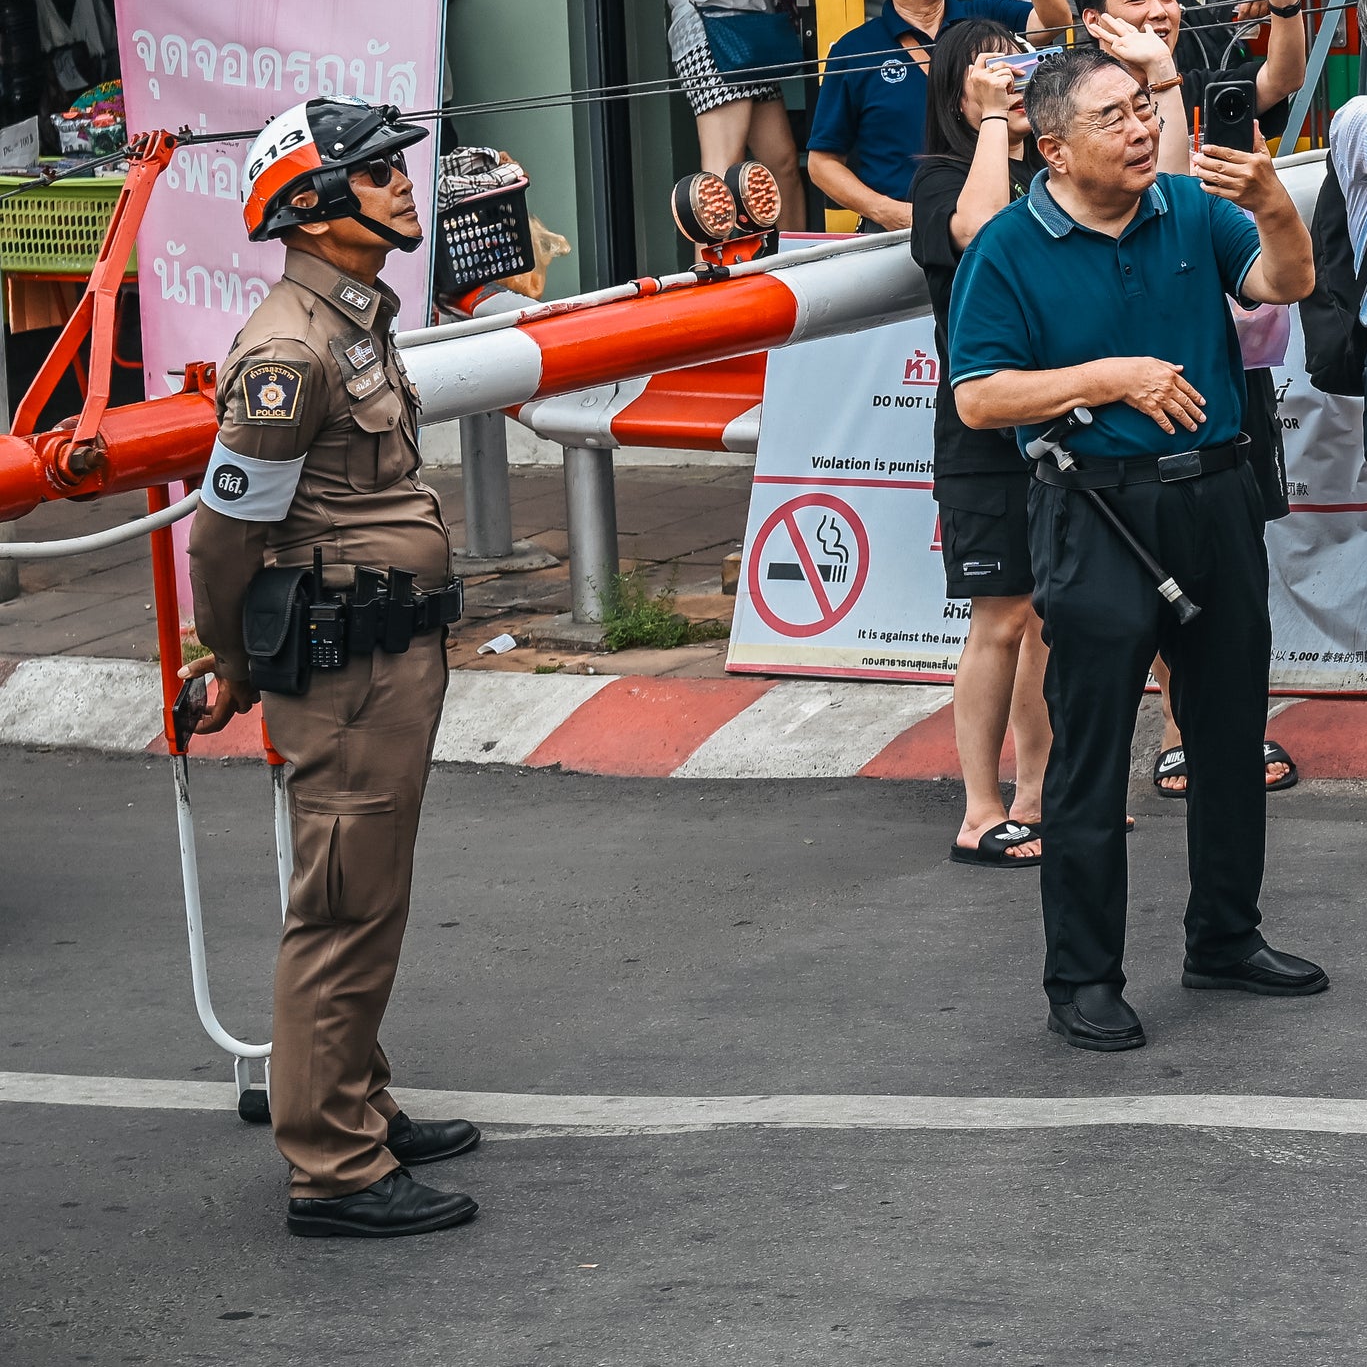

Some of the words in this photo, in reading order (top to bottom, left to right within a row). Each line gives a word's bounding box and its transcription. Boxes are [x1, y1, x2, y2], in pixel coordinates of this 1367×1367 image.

[132, 28, 418, 110] จุดจอดรถบัส
[250, 129, 306, 182] 613
[904, 349, 940, 380] ห้า
[872, 395, 892, 407] DO
[894, 395, 922, 408] NOT
[255, 409, 287, 417] POLICE
[811, 456, 871, 471] Violation
[874, 457, 885, 471] is
[858, 629, 866, 639] It
[868, 629, 878, 640] is
[880, 630, 919, 643] against
[921, 631, 940, 644] the
[941, 632, 961, 644] law
[1288, 651, 1319, 663] 5,000
